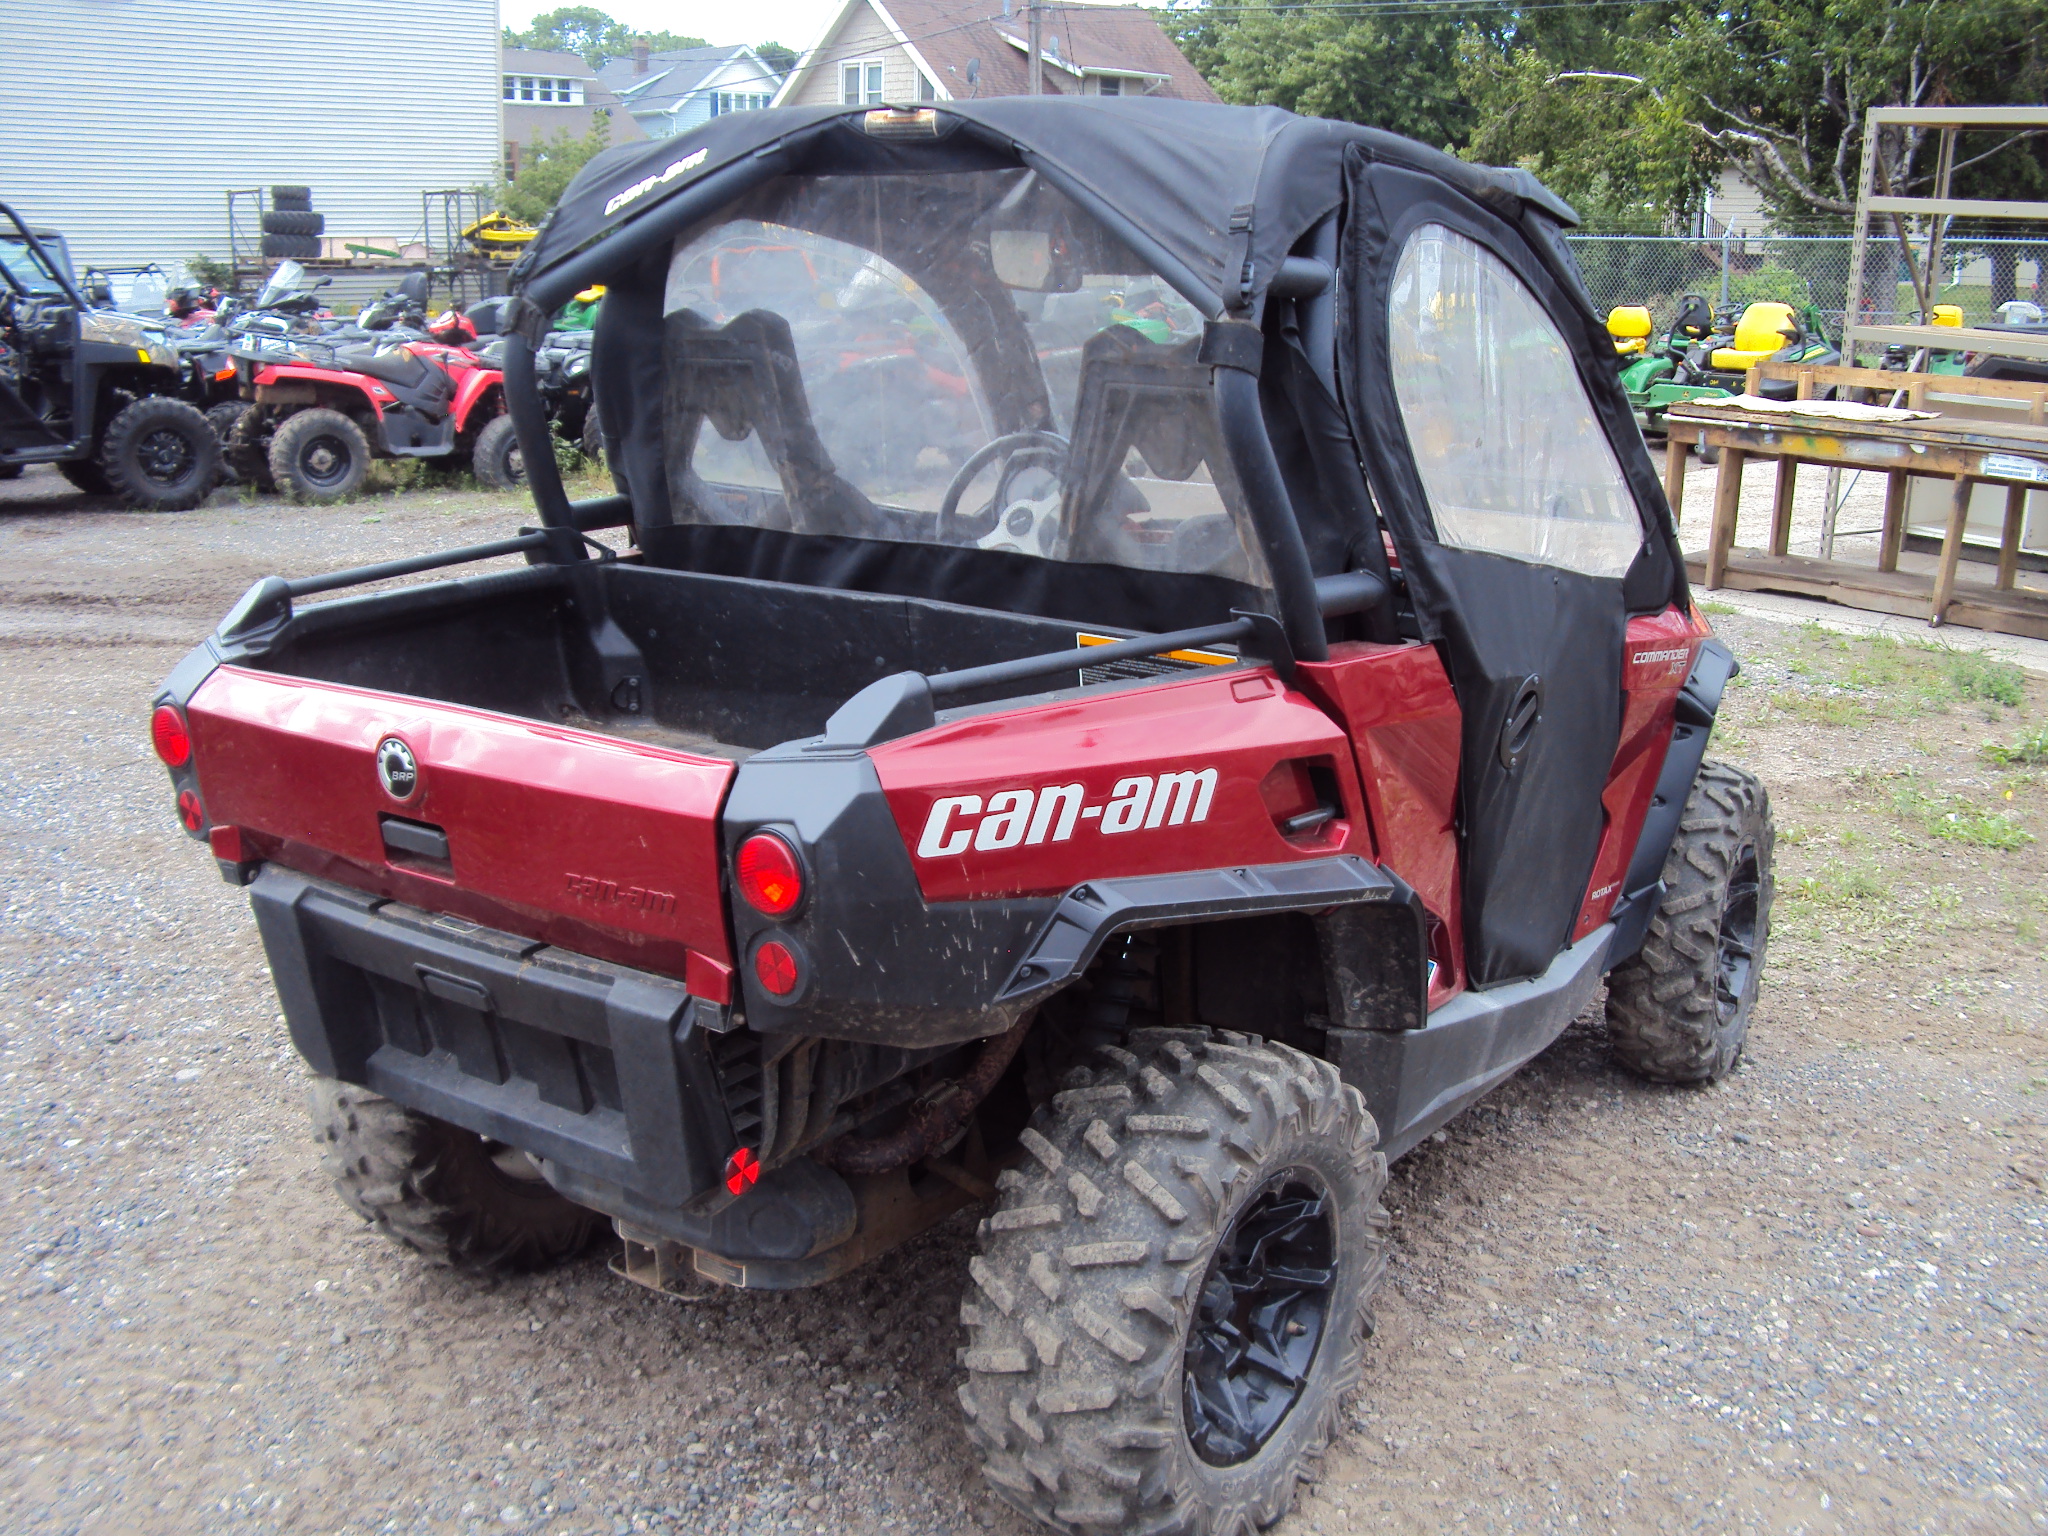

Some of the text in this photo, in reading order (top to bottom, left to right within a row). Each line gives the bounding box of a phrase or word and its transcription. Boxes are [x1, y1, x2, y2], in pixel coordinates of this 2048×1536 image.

[603, 147, 708, 216] can-am
[1632, 648, 1689, 664] COMMANDER
[1667, 660, 1687, 675] XT
[391, 770, 414, 781] BRP
[917, 767, 1218, 859] can-am
[563, 872, 677, 914] can-am
